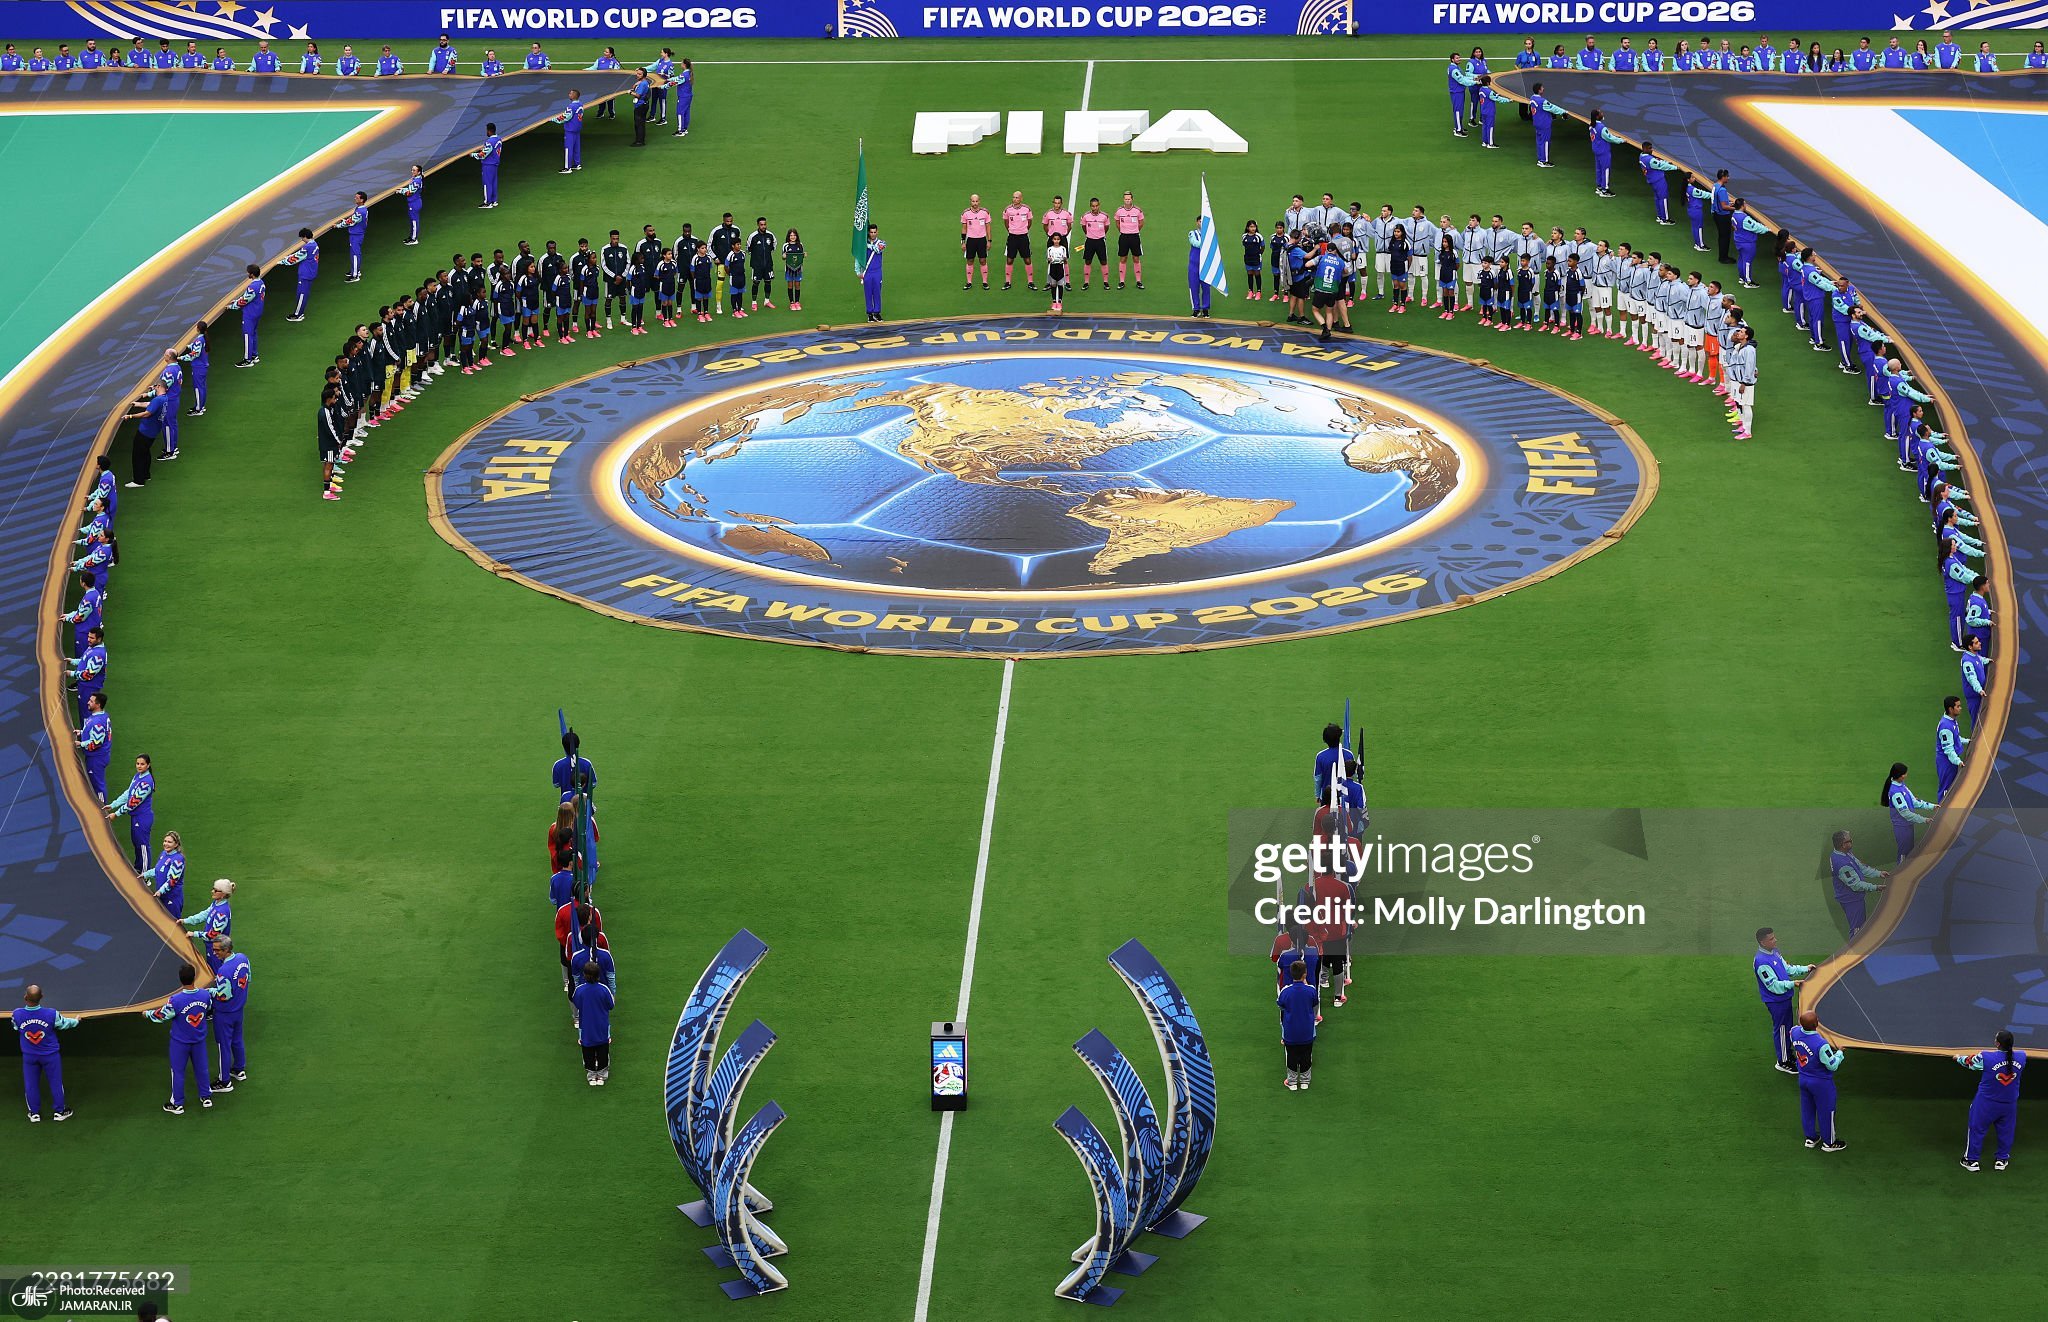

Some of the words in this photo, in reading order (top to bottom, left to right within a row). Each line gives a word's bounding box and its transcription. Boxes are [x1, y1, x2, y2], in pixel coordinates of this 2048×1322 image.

[440, 8, 498, 29] FIFA
[501, 8, 599, 29] WORLD
[603, 7, 658, 28] CUP
[923, 7, 983, 29] FIFA
[987, 7, 1092, 28] WORLD
[1096, 6, 1152, 28] CUP
[1433, 3, 1491, 24] FIFA
[1494, 3, 1595, 24] WORLD
[1599, 2, 1654, 23] CUP
[912, 109, 1248, 154] FIFA
[922, 329, 1039, 344] CUP
[1052, 329, 1263, 351] WORLD
[1280, 342, 1401, 372] FIFA
[483, 439, 573, 502] FIFA
[1517, 432, 1597, 496] FIFA
[620, 574, 750, 613] FIFA
[763, 600, 1020, 634] WORLD
[1035, 612, 1179, 633] CUP
[180, 1001, 208, 1014] VOLUNTEER
[20, 1019, 49, 1030] VOLUNTEER
[1792, 1040, 1814, 1056] OLUNTEER
